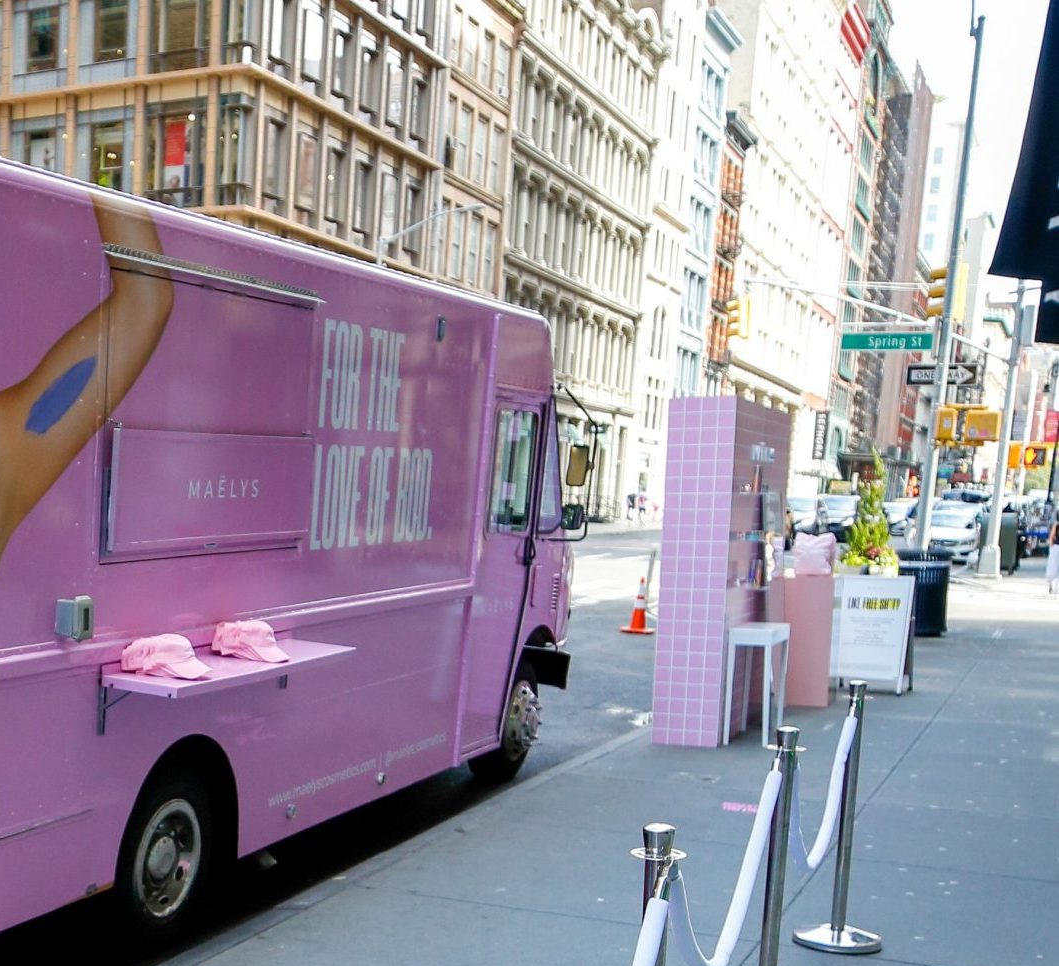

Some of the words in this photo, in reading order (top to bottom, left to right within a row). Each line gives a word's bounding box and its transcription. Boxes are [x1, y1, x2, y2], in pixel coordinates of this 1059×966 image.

[868, 336, 905, 349] Spring
[911, 336, 922, 347] St
[318, 318, 364, 430] FOR
[366, 327, 405, 432] THE
[814, 413, 827, 457] SEPHORA
[189, 475, 259, 499] MAËLYS
[309, 444, 365, 551] LOVE
[365, 446, 394, 546] OF
[393, 448, 433, 543] BOD.
